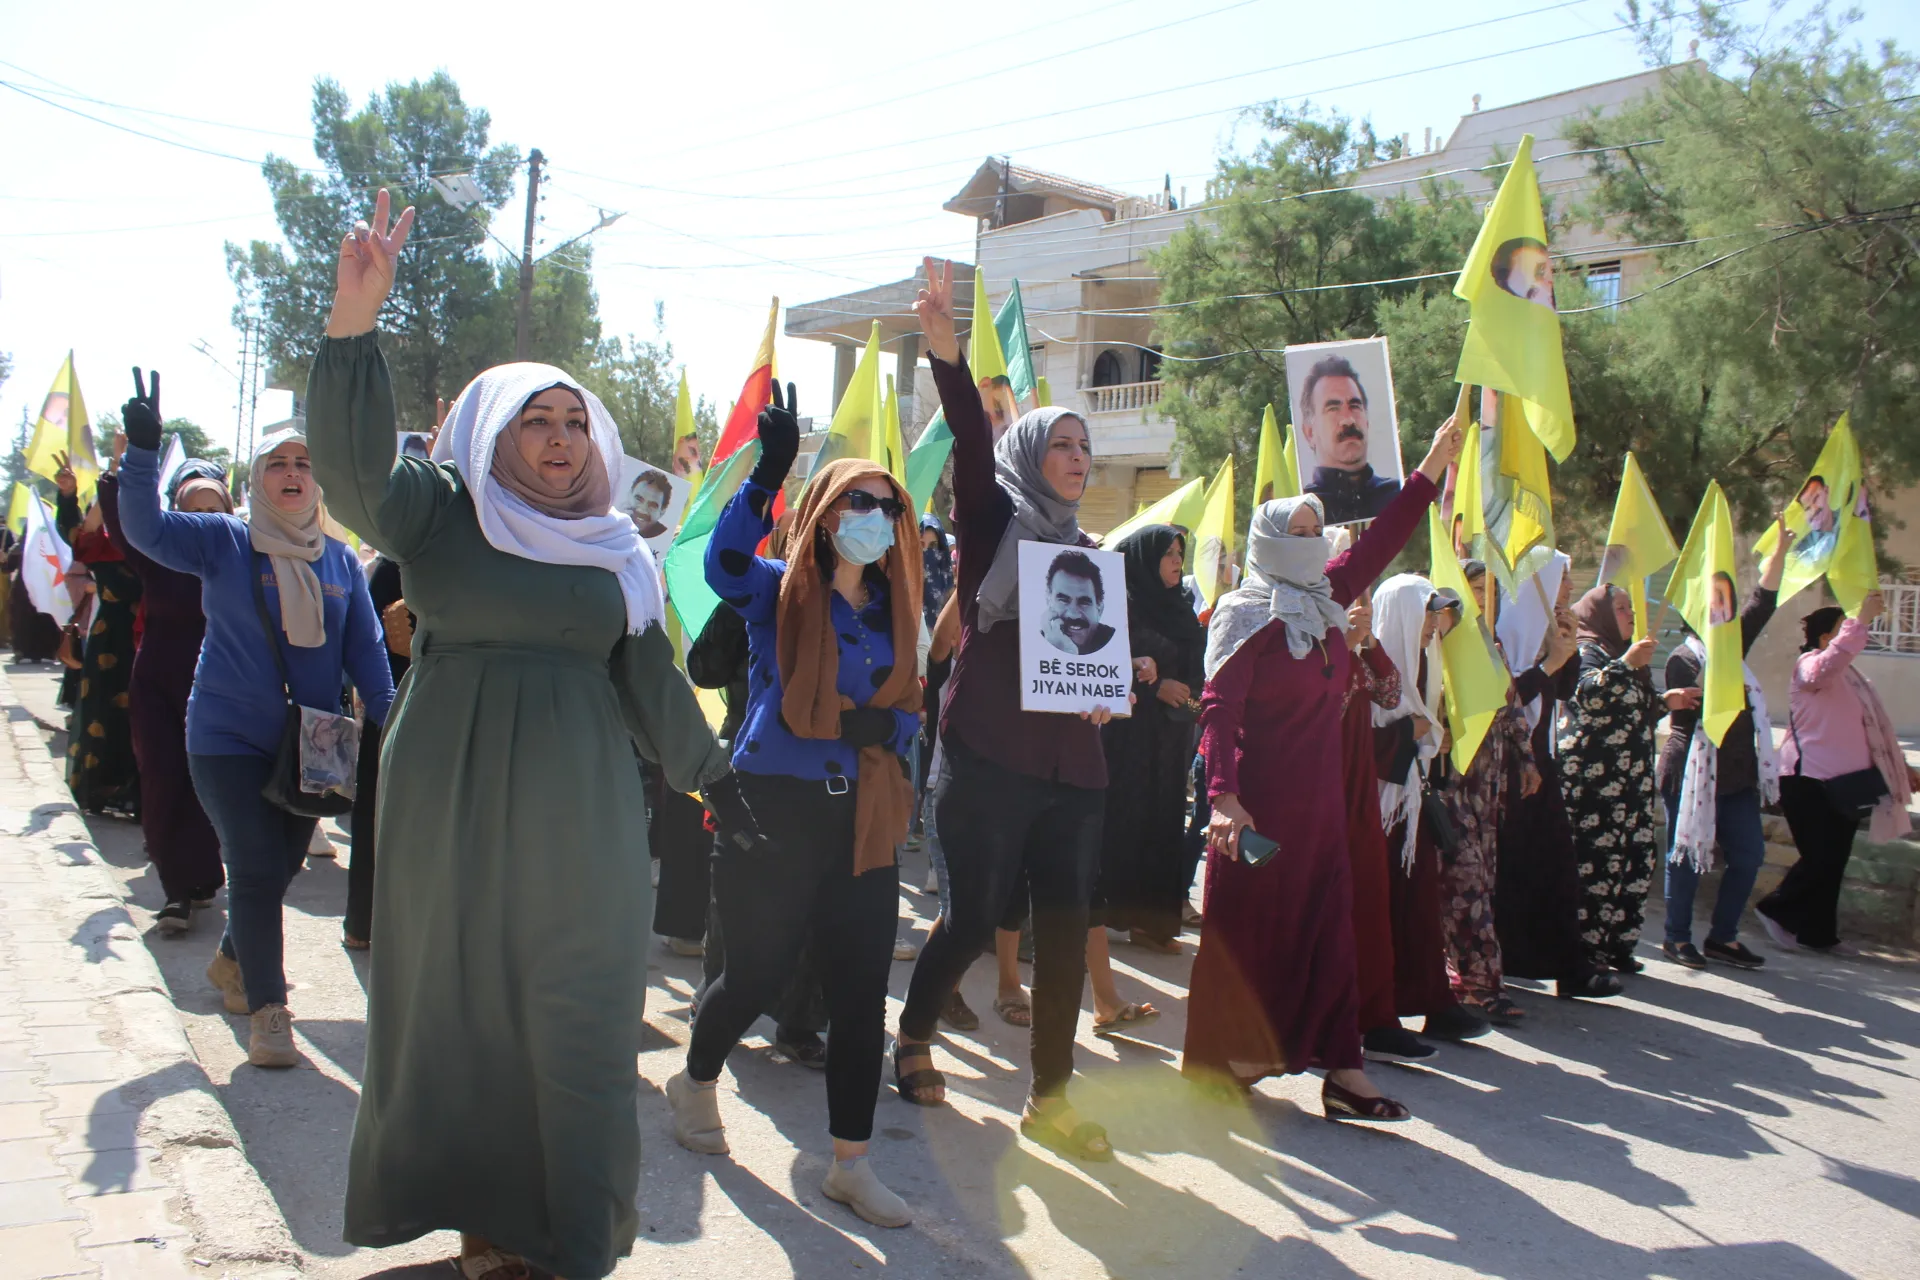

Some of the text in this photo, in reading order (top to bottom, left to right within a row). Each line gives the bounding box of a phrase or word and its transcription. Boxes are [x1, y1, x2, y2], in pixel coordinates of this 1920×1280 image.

[1039, 658, 1119, 679] BÊ SEROK
[1032, 680, 1126, 698] JIYAN NABE
